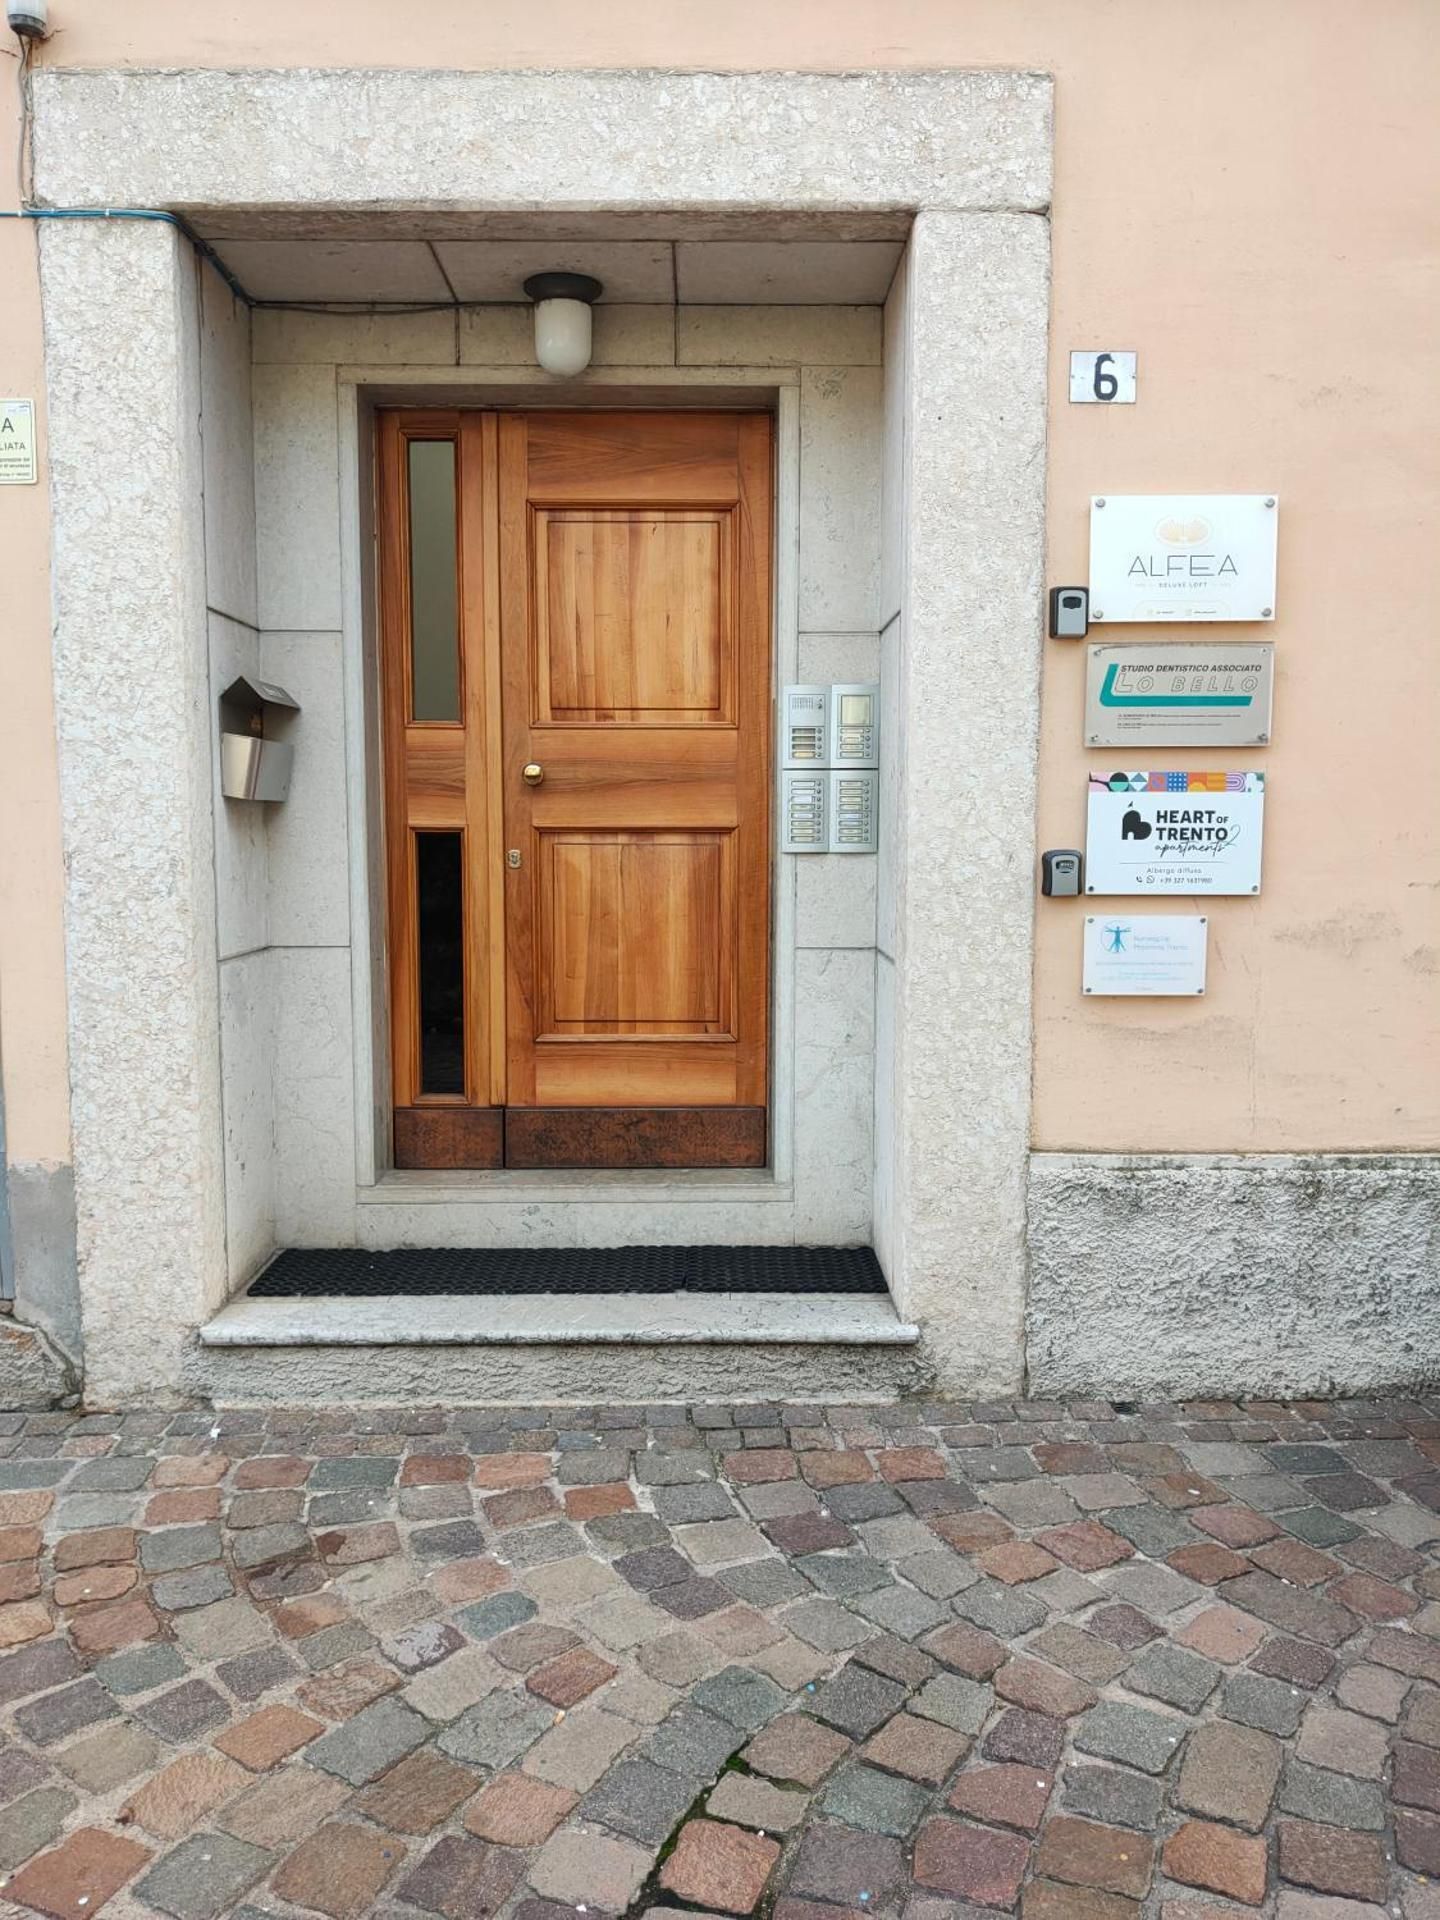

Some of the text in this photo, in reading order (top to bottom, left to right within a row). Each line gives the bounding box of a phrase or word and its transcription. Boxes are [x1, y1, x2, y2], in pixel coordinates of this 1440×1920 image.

[1094, 353, 1118, 401] 6
[1128, 554, 1239, 577] ALFEA
[1121, 664, 1262, 673] STUDIO DENTISTICO ASSOCIATO
[1114, 673, 1259, 693] LO BELLO
[1156, 810, 1229, 824] HEART OF
[1155, 827, 1229, 841] TRENTO
[1154, 836, 1241, 858] apartments
